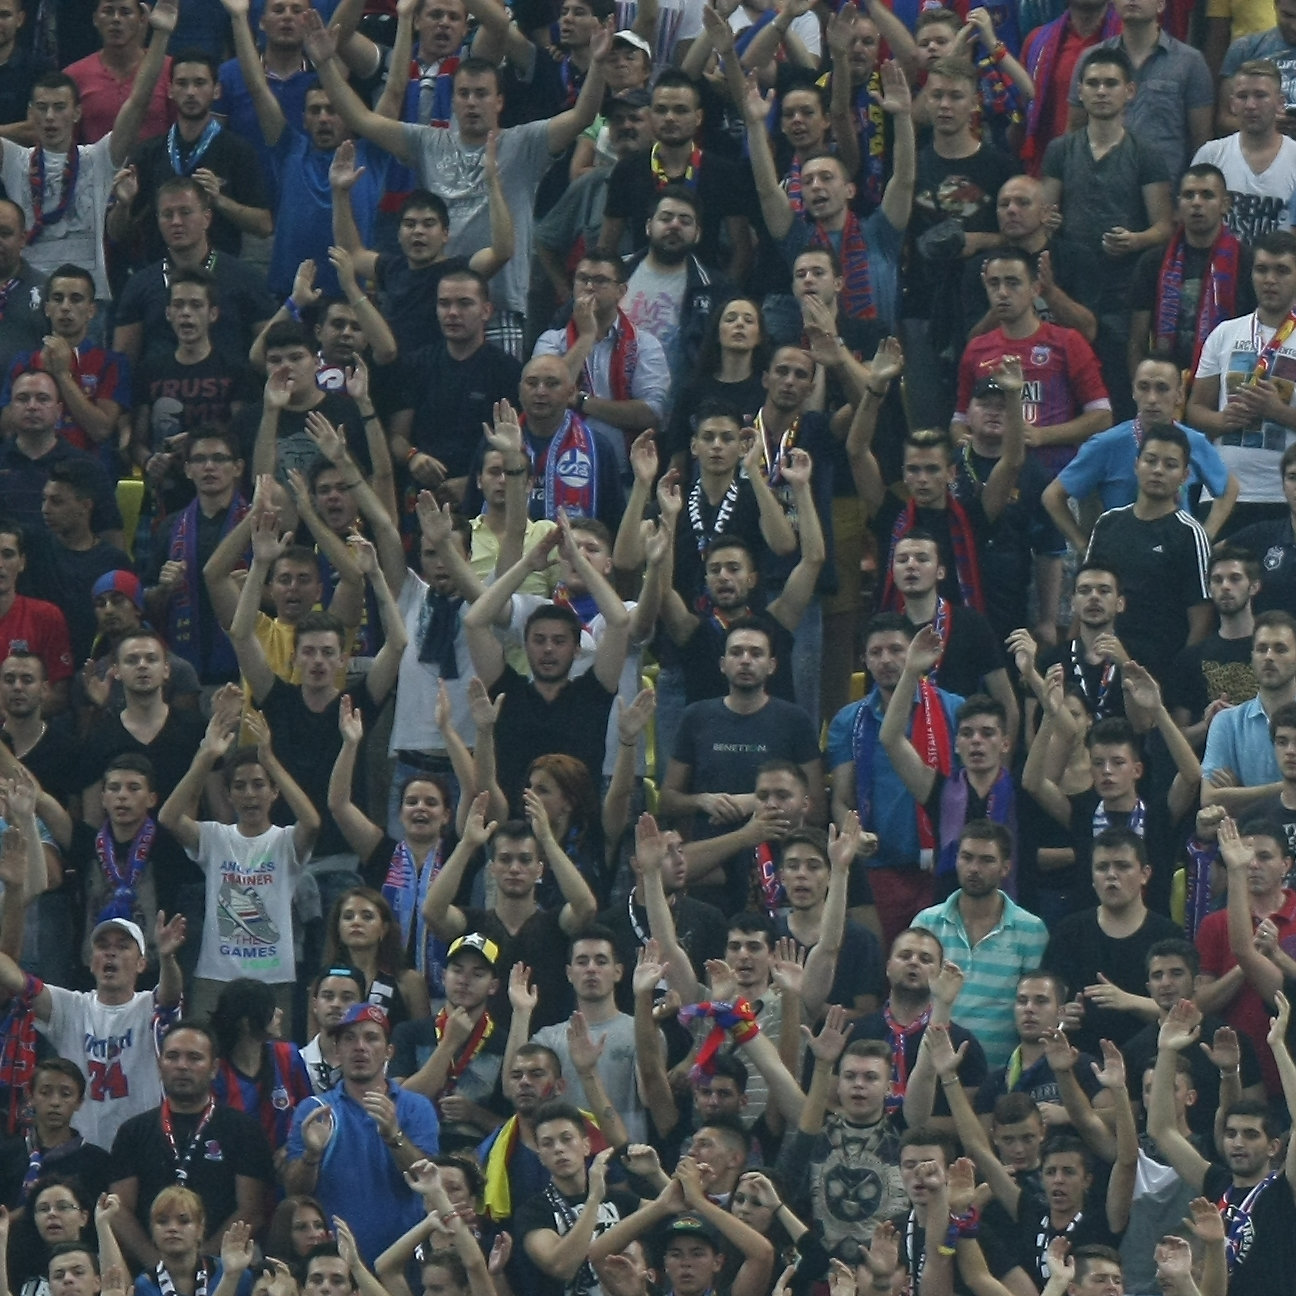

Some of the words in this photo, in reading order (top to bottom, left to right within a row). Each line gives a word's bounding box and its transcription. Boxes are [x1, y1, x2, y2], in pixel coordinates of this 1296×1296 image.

[712, 742, 770, 755] BENETTON
[219, 944, 277, 959] GAMES
[89, 1060, 129, 1102] 24
